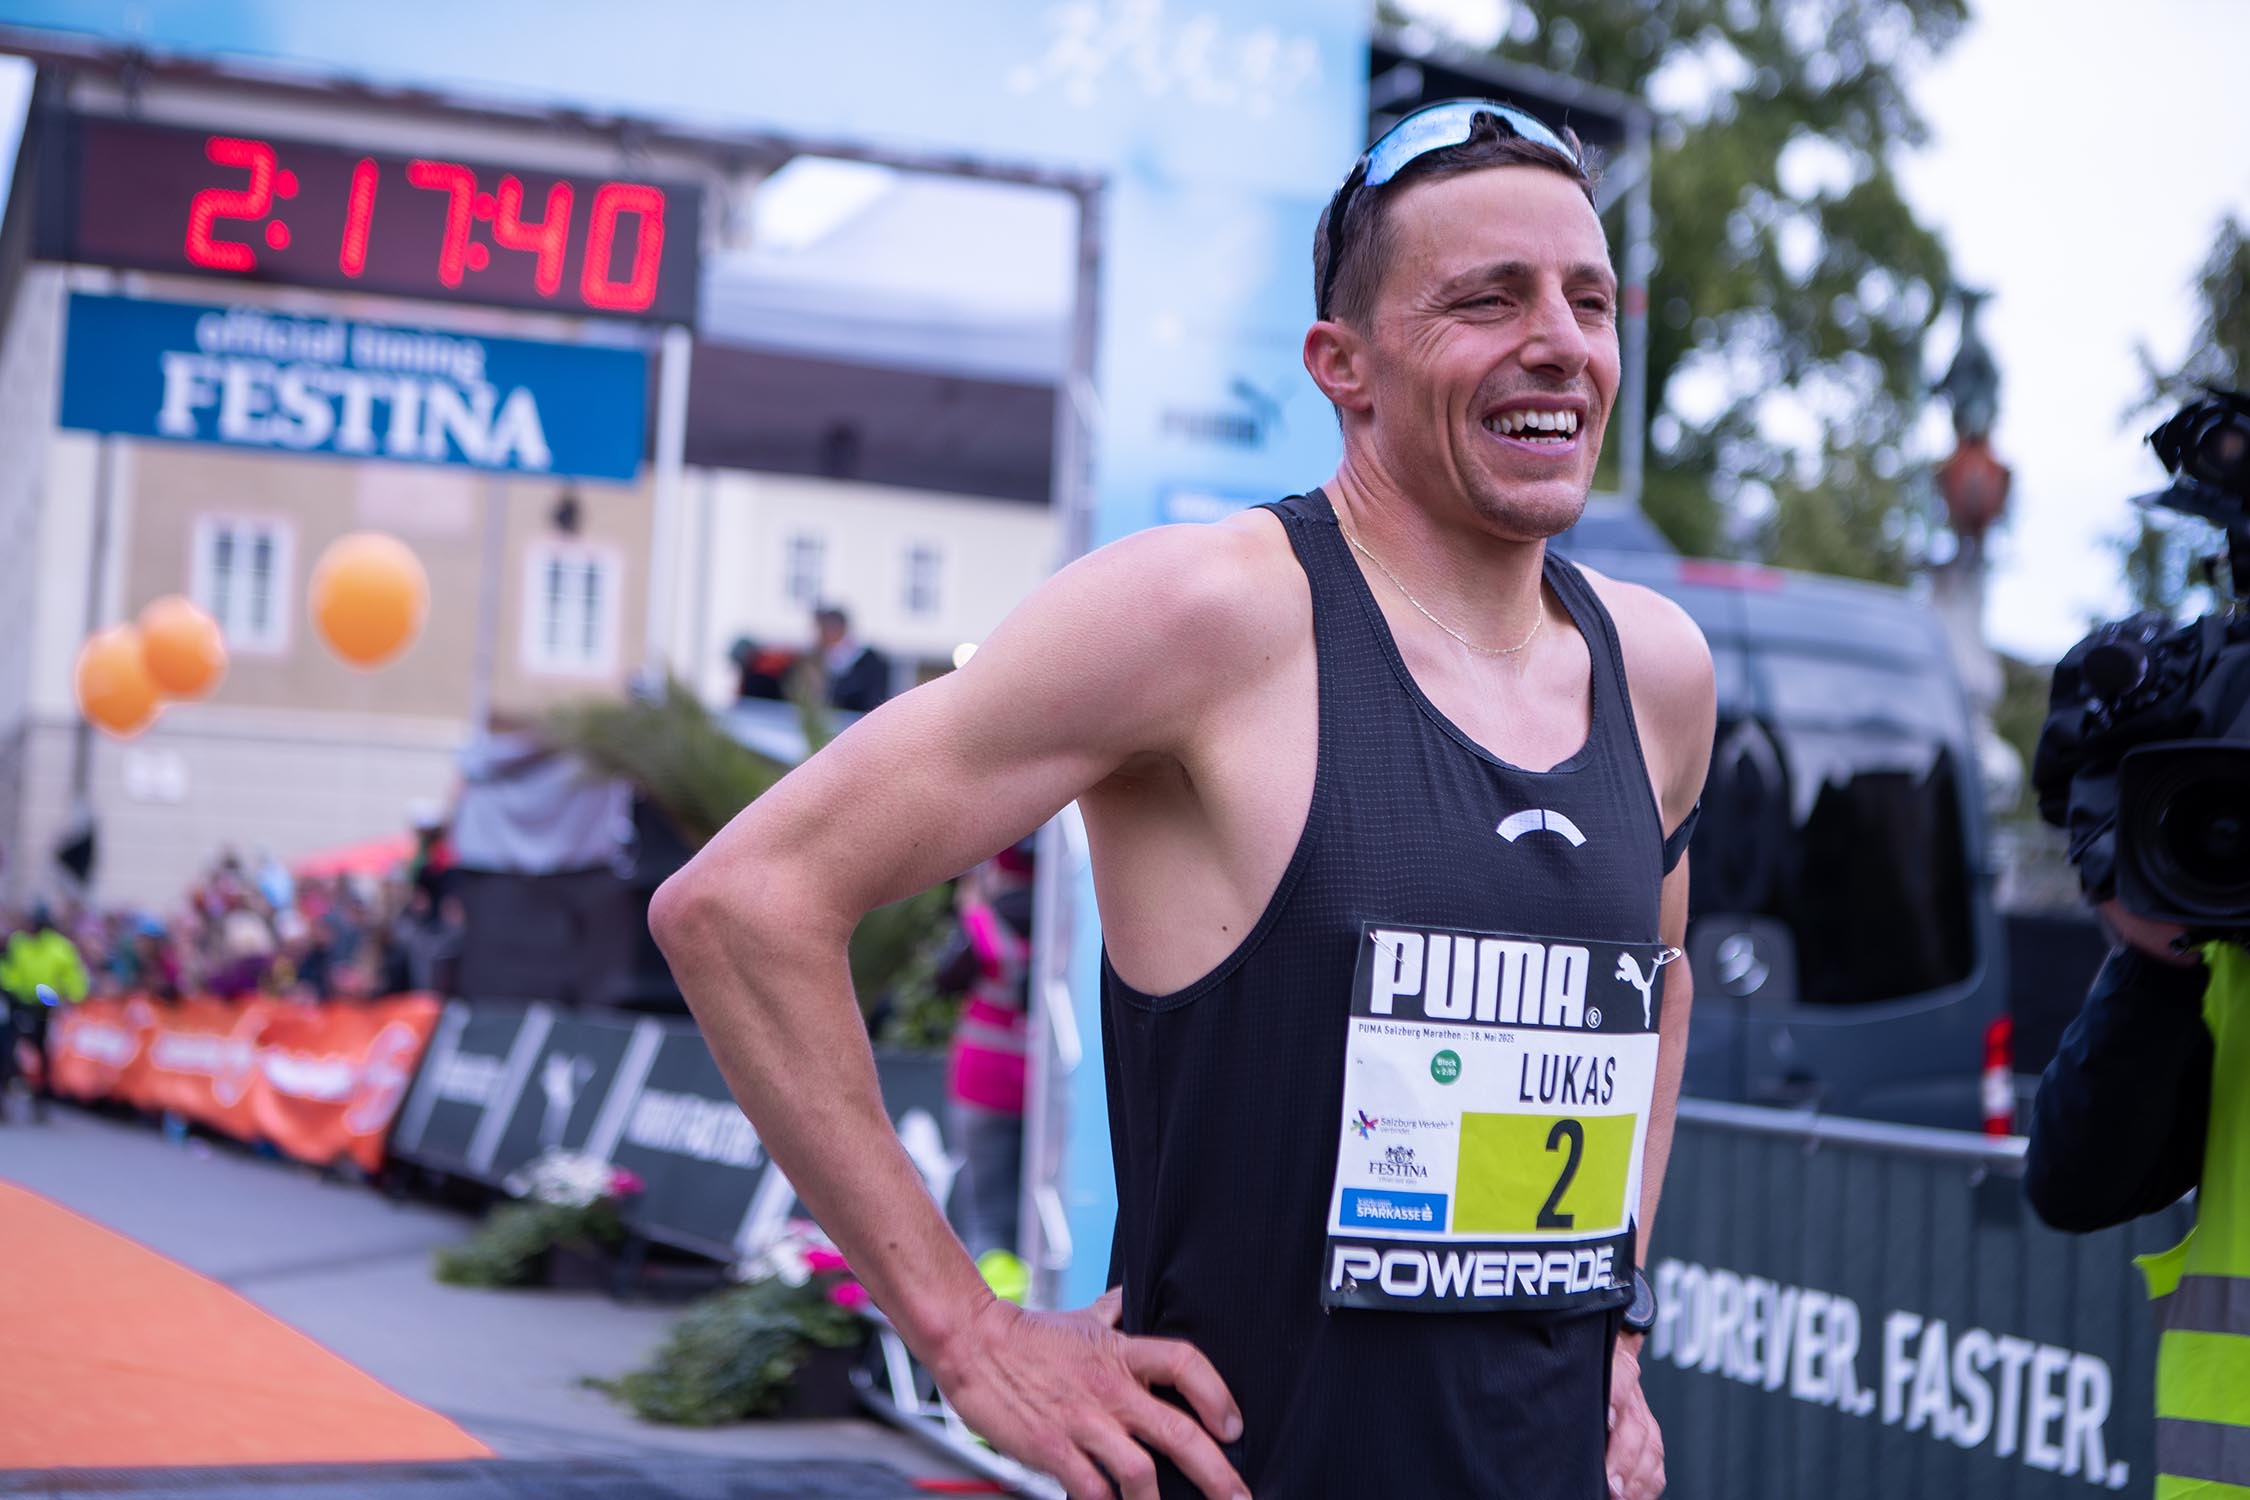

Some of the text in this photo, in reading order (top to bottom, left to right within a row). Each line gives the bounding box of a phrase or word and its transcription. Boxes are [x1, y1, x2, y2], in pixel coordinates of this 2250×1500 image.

[185, 136, 666, 312] 2:17:40
[157, 350, 553, 471] FESTINA
[1358, 1023, 1383, 1035] PUMA
[1384, 1025, 1421, 1039] Salzburg
[1423, 1028, 1461, 1041] Marathon
[1519, 1052, 1616, 1106] LUKAS
[1380, 1118, 1417, 1129] Salzburg
[1369, 1162, 1428, 1178] FESTINA
[1535, 1119, 1585, 1232] 2
[1356, 1206, 1422, 1221] SPARKASSE
[1330, 1244, 1613, 1298] POWERADE
[1652, 1256, 2130, 1490] FOREVER. FASTER.
